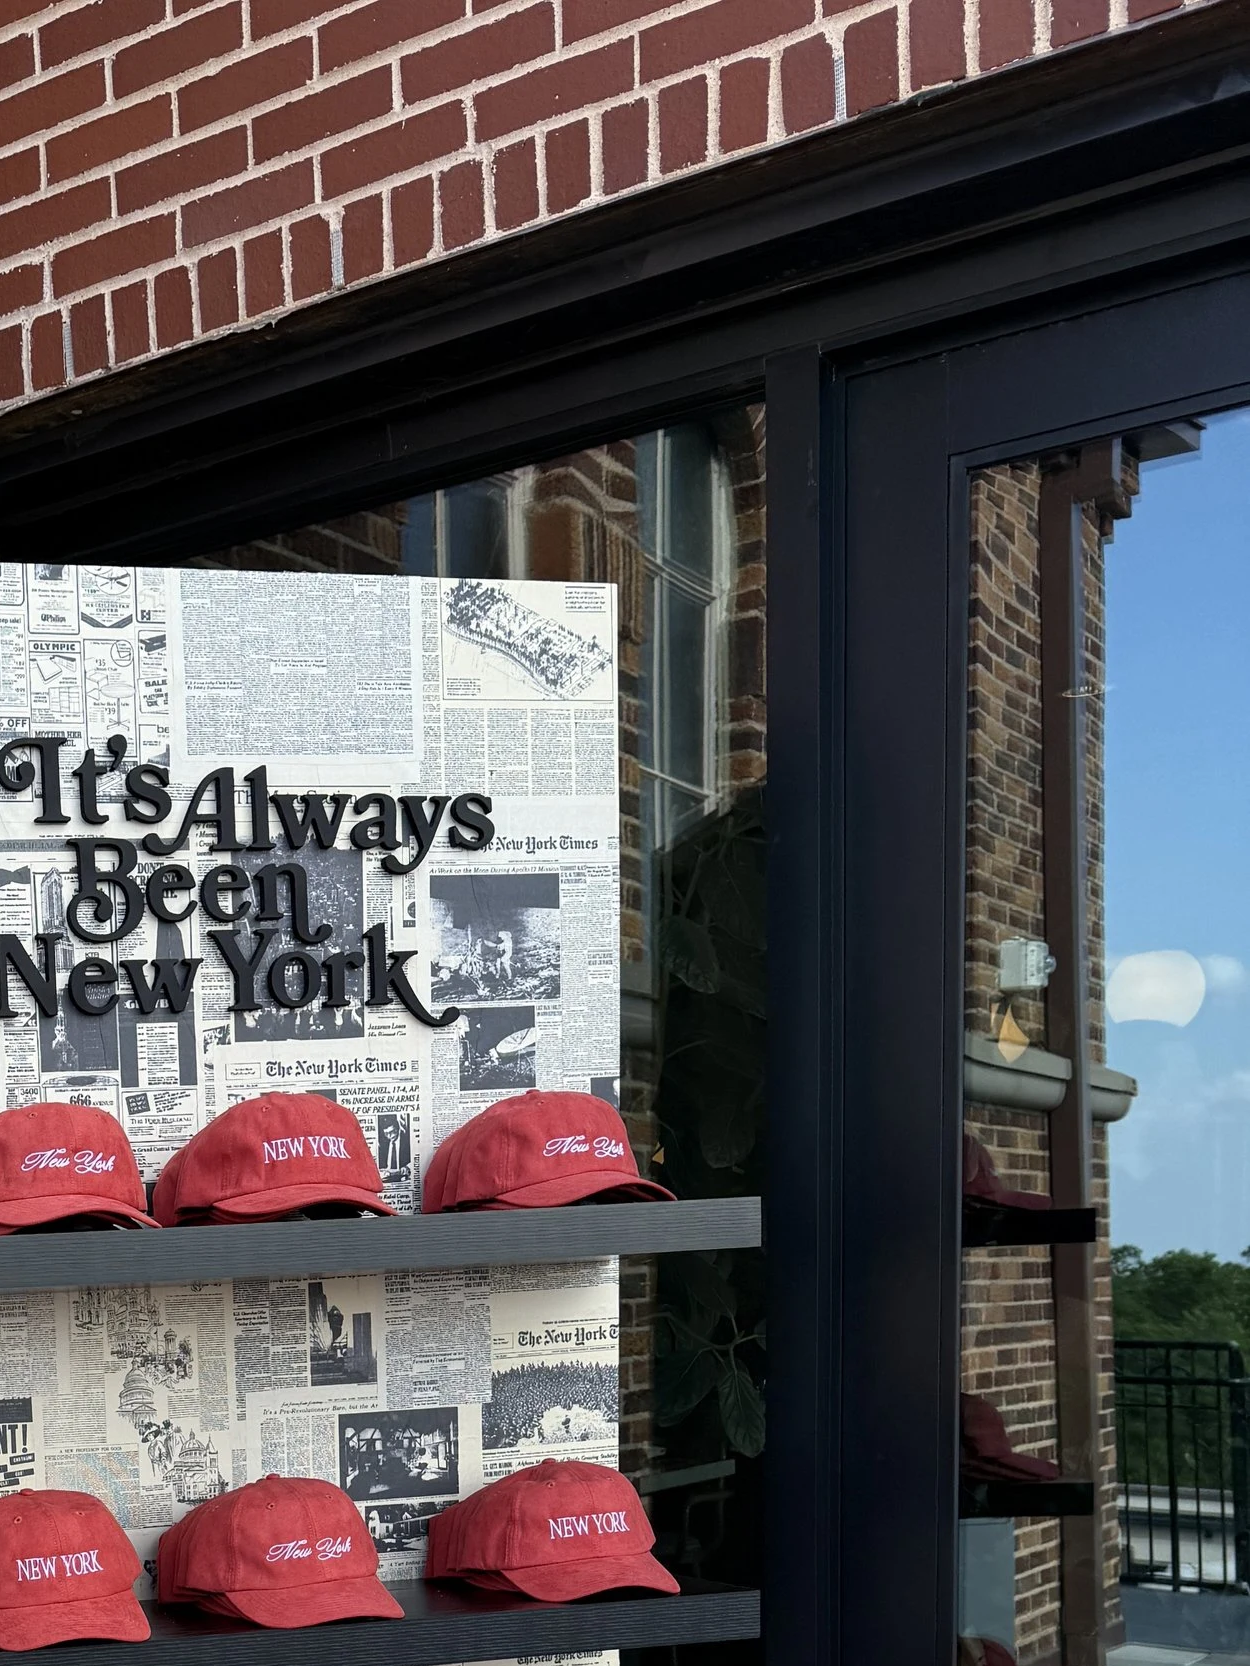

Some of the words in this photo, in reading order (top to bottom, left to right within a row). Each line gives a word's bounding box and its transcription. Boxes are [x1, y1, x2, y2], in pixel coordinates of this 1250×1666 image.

[33, 642, 76, 651] OLYMPIC
[7, 718, 28, 727] OFF
[142, 764, 496, 874] Always
[496, 836, 523, 852] New
[525, 835, 558, 855] York
[559, 835, 599, 850] Times
[65, 837, 333, 945] Been
[207, 922, 461, 1028] York
[265, 1060, 292, 1078] The
[294, 1060, 325, 1076] New
[327, 1058, 363, 1078] York
[365, 1057, 407, 1073] Times
[338, 1087, 367, 1096] SENATE
[352, 1095, 387, 1105] INCREASE
[387, 1095, 395, 1103] IN
[395, 1094, 415, 1103] ARMS
[362, 1106, 372, 1114] OF
[372, 1103, 415, 1114] PRESIDENT'S
[263, 1136, 305, 1164] NEW
[307, 1135, 351, 1160] YORK
[542, 1136, 590, 1159] New
[21, 1148, 70, 1172] New
[74, 1150, 117, 1173] York
[518, 1329, 543, 1348] The
[544, 1328, 572, 1346] New
[574, 1325, 607, 1346] York
[548, 1513, 591, 1540] NEW
[595, 1511, 630, 1535] YORK
[265, 1538, 312, 1563] New
[315, 1536, 352, 1561] York
[17, 1556, 56, 1582] NEW
[59, 1549, 104, 1577] YORK
